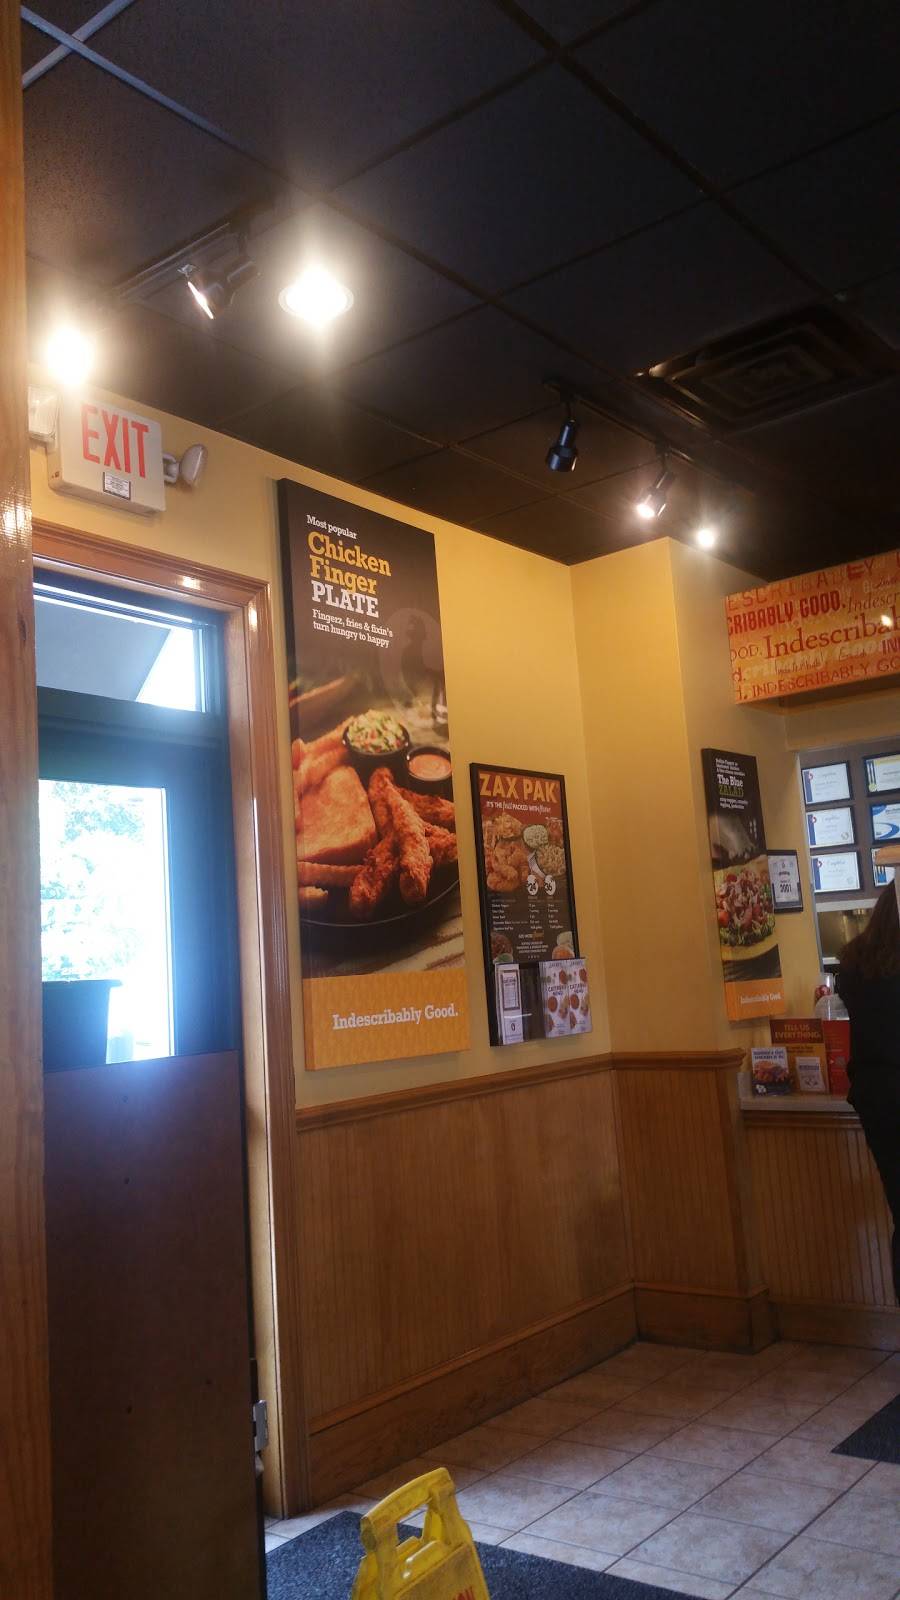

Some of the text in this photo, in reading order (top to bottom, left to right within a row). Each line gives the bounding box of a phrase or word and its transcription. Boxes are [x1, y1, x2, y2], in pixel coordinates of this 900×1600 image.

[81, 403, 149, 479] EXIT
[306, 514, 358, 540] Most popular
[308, 531, 392, 577] Chicken
[309, 554, 377, 594] Finger
[311, 580, 379, 618] PLATE
[312, 608, 393, 638] Fingerz, fries & fixin's
[313, 620, 390, 648] turn hungry to happy
[480, 773, 558, 803] ZAX PAK
[717, 774, 743, 787] The Blue
[332, 1002, 459, 1030] Indescribably Good.
